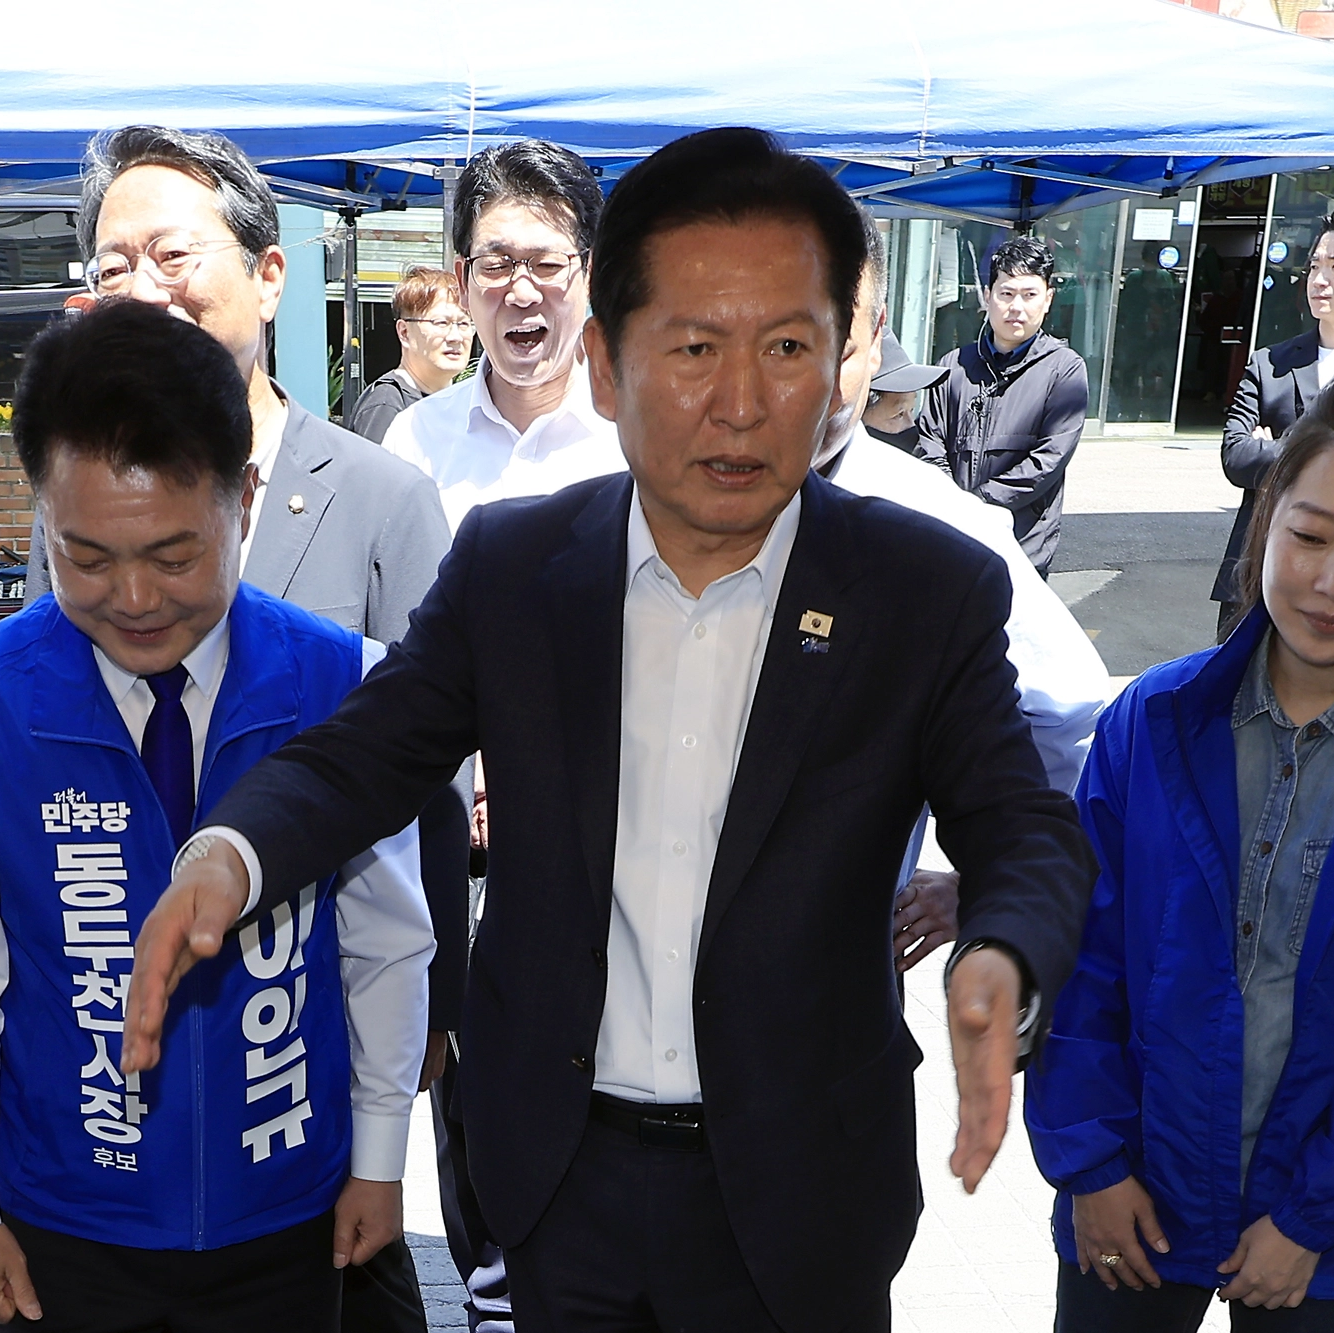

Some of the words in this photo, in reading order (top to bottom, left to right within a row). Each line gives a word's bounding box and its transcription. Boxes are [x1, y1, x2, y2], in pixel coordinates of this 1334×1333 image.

[53, 787, 87, 806] 더불어
[41, 802, 131, 833] 민주당
[54, 843, 148, 1144] 동두천시장
[92, 1147, 139, 1173] 후보
